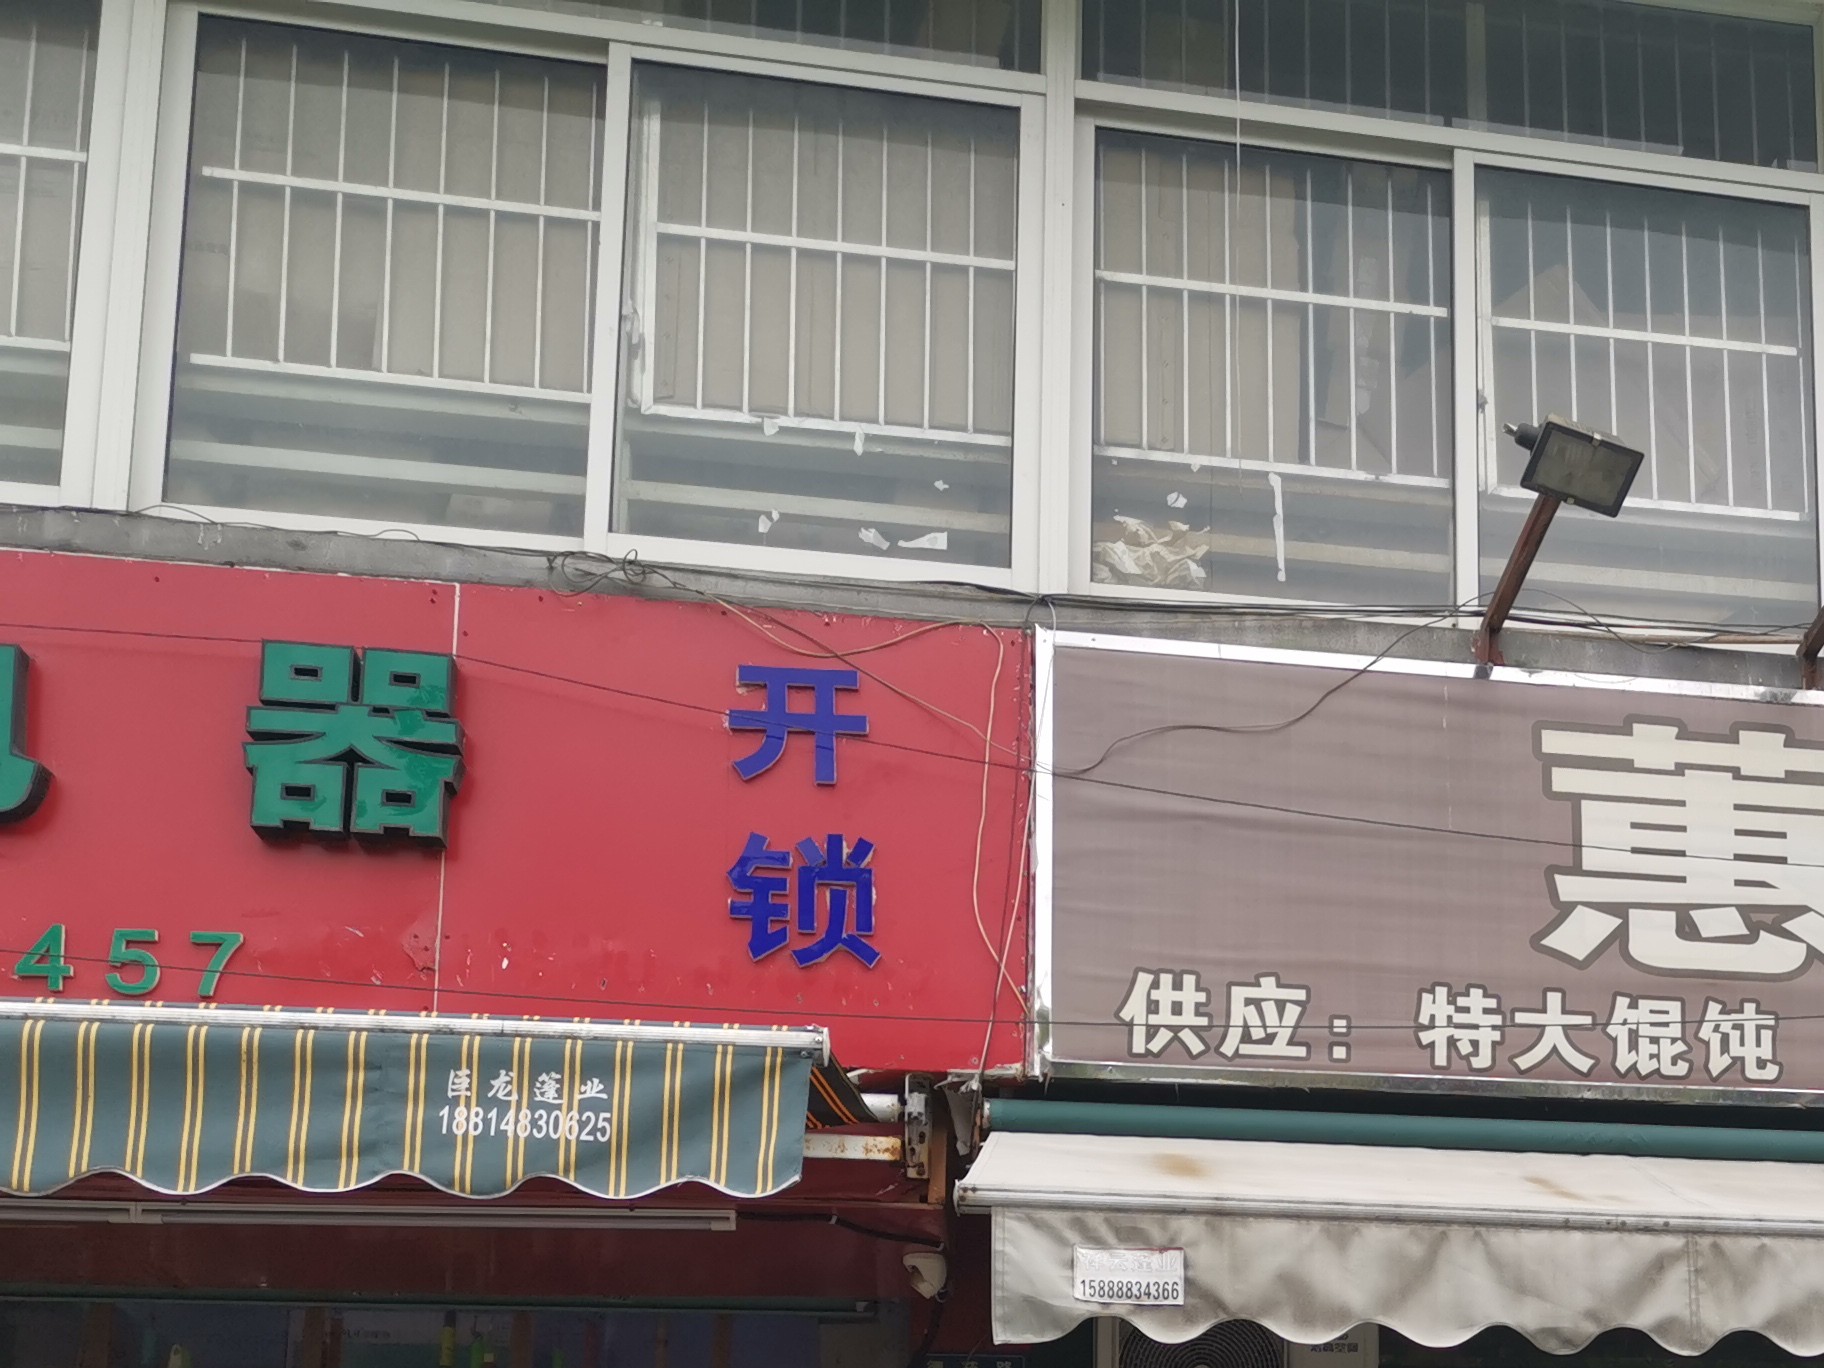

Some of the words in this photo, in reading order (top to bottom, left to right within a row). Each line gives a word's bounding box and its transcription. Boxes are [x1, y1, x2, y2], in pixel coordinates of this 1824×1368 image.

[727, 664, 881, 968] 开锁
[15, 924, 245, 997] 457
[1418, 984, 1782, 1083] 特大馄饨
[439, 1105, 612, 1143] 18814830625
[1080, 1279, 1180, 1301] 15888834366
